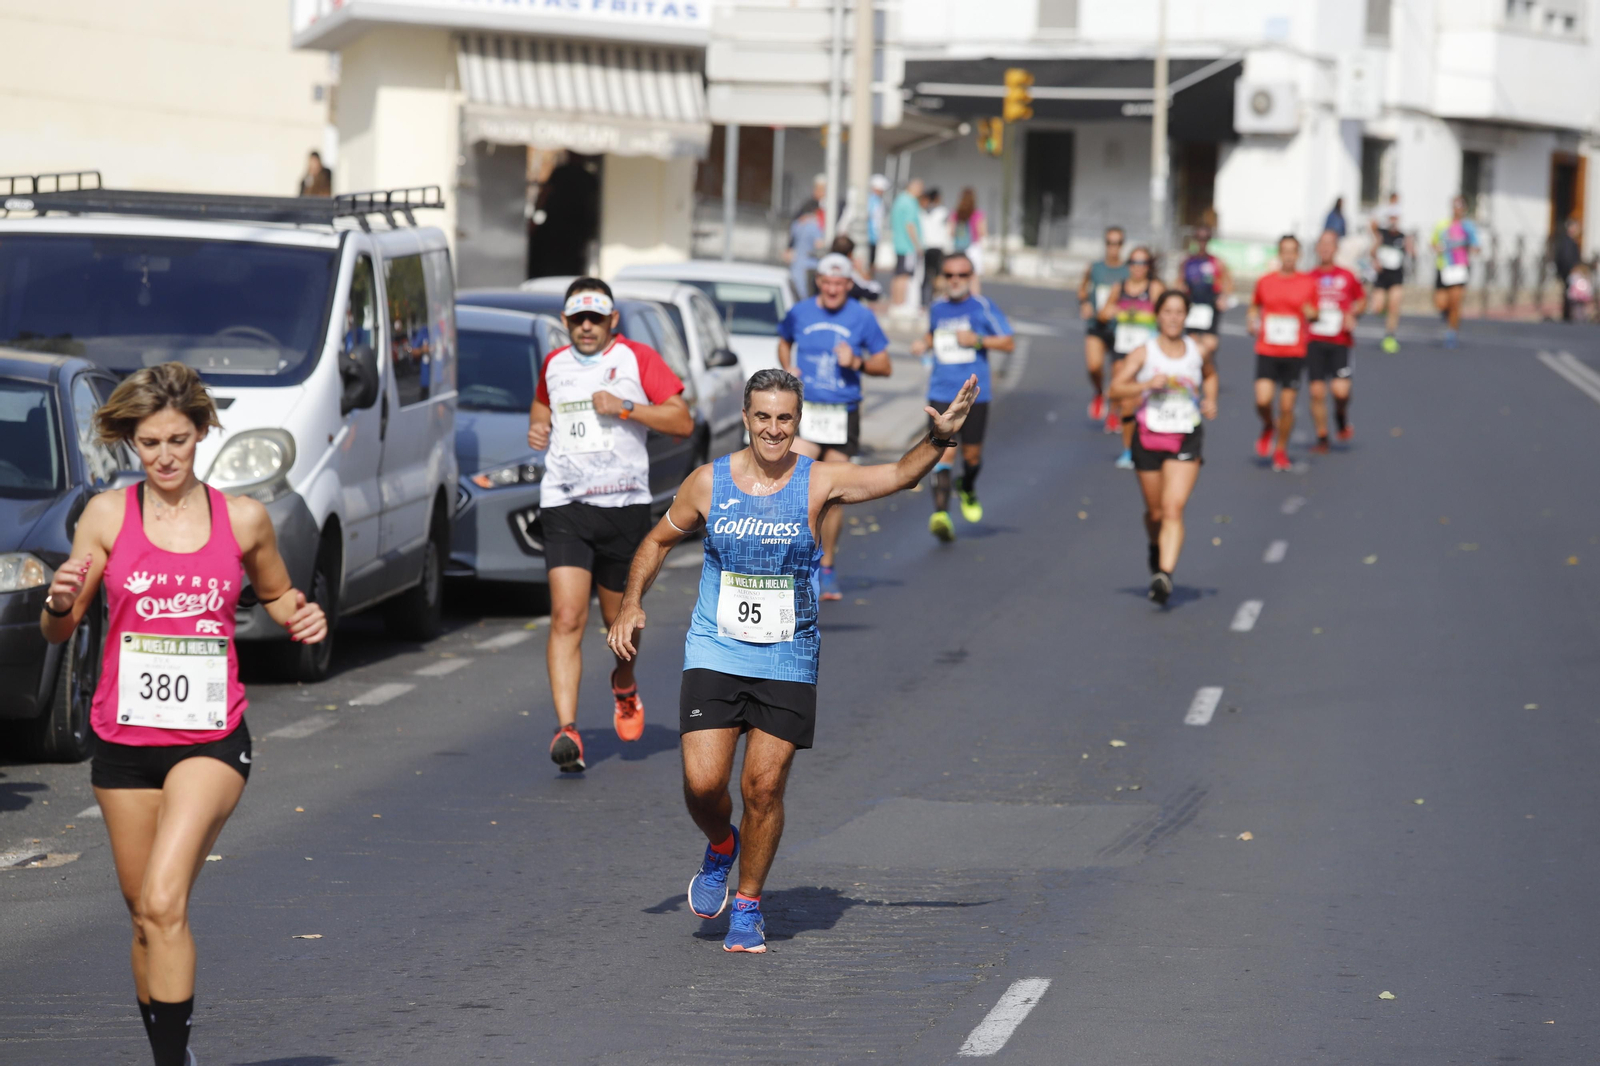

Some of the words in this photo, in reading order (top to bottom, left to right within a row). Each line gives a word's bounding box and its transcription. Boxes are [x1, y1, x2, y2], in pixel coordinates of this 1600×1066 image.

[570, 421, 586, 439] 40
[714, 516, 801, 540] Golfitness
[761, 537, 792, 545] LIFESTYLE
[156, 573, 232, 592] HYROX
[735, 576, 758, 588] VUELTA
[759, 579, 765, 588] A
[765, 579, 788, 589] HUELVA
[737, 588, 761, 596] ALFONSO
[136, 589, 225, 622] Queen
[737, 601, 762, 625] 95
[195, 618, 224, 634] FSC
[142, 639, 177, 654] VUELTA
[178, 641, 186, 654] A
[187, 641, 221, 655] HUELVA
[140, 672, 189, 702] 380
